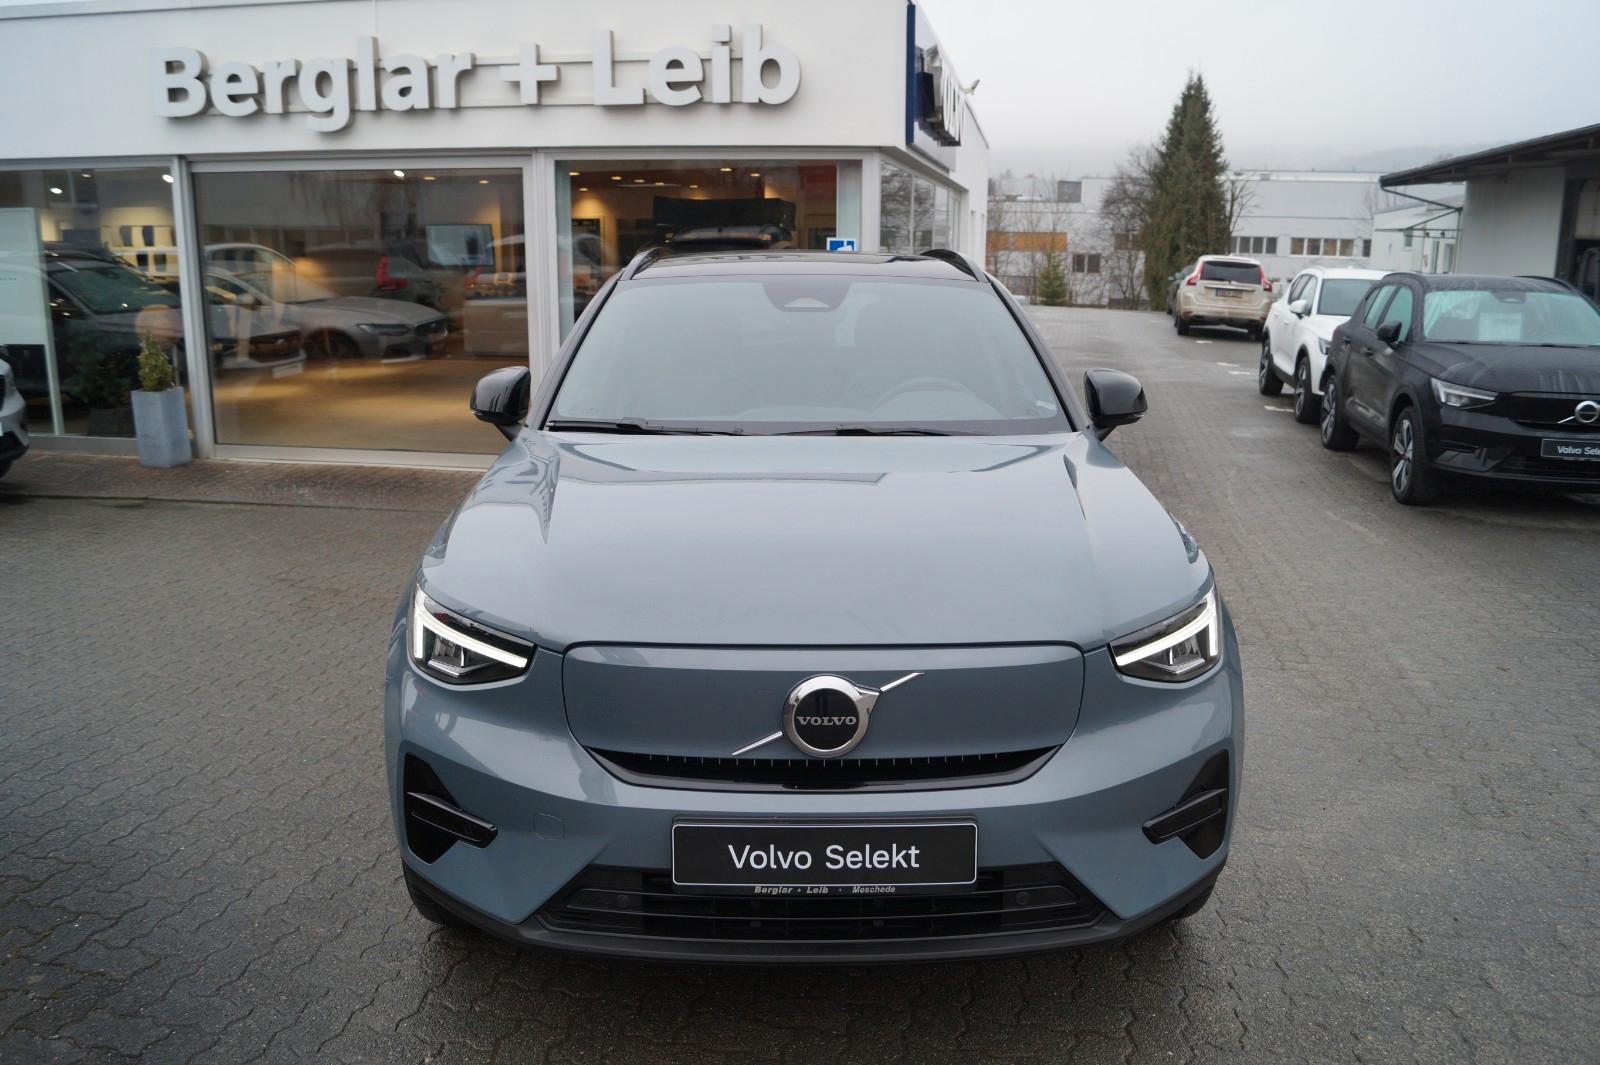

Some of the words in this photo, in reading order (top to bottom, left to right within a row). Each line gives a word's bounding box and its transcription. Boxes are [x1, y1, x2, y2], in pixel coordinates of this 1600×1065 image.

[153, 35, 476, 132] Berglar
[500, 43, 563, 106] +
[592, 24, 801, 107] Leib
[1557, 445, 1582, 455] Volvo
[796, 716, 857, 726] VOLVO
[728, 844, 813, 870] Volvo
[825, 843, 921, 870] Selekt
[754, 885, 794, 895] Berglar
[806, 885, 829, 894] Leib
